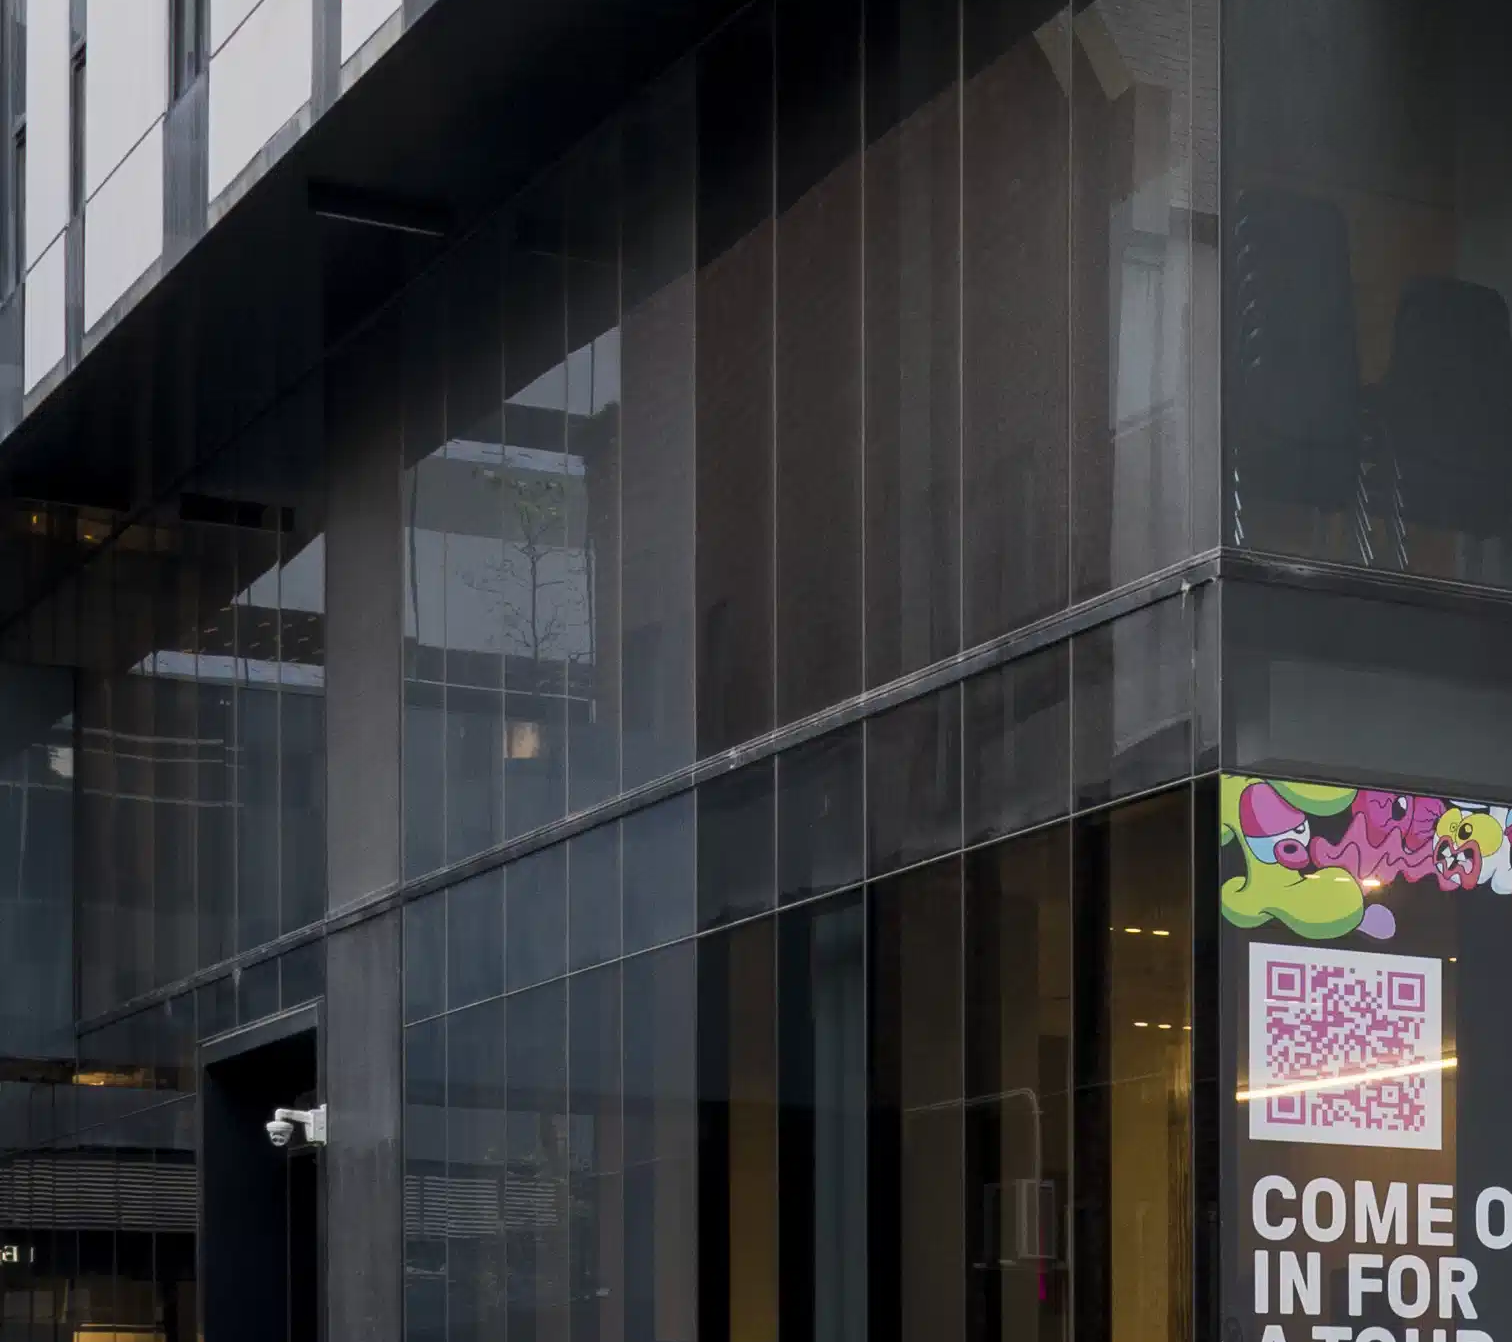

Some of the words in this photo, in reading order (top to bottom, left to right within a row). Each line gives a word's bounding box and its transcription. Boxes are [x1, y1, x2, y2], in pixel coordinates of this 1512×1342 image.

[1252, 1175, 1454, 1247] COME
[1254, 1250, 1321, 1315] IN
[1348, 1253, 1478, 1320] FOR
